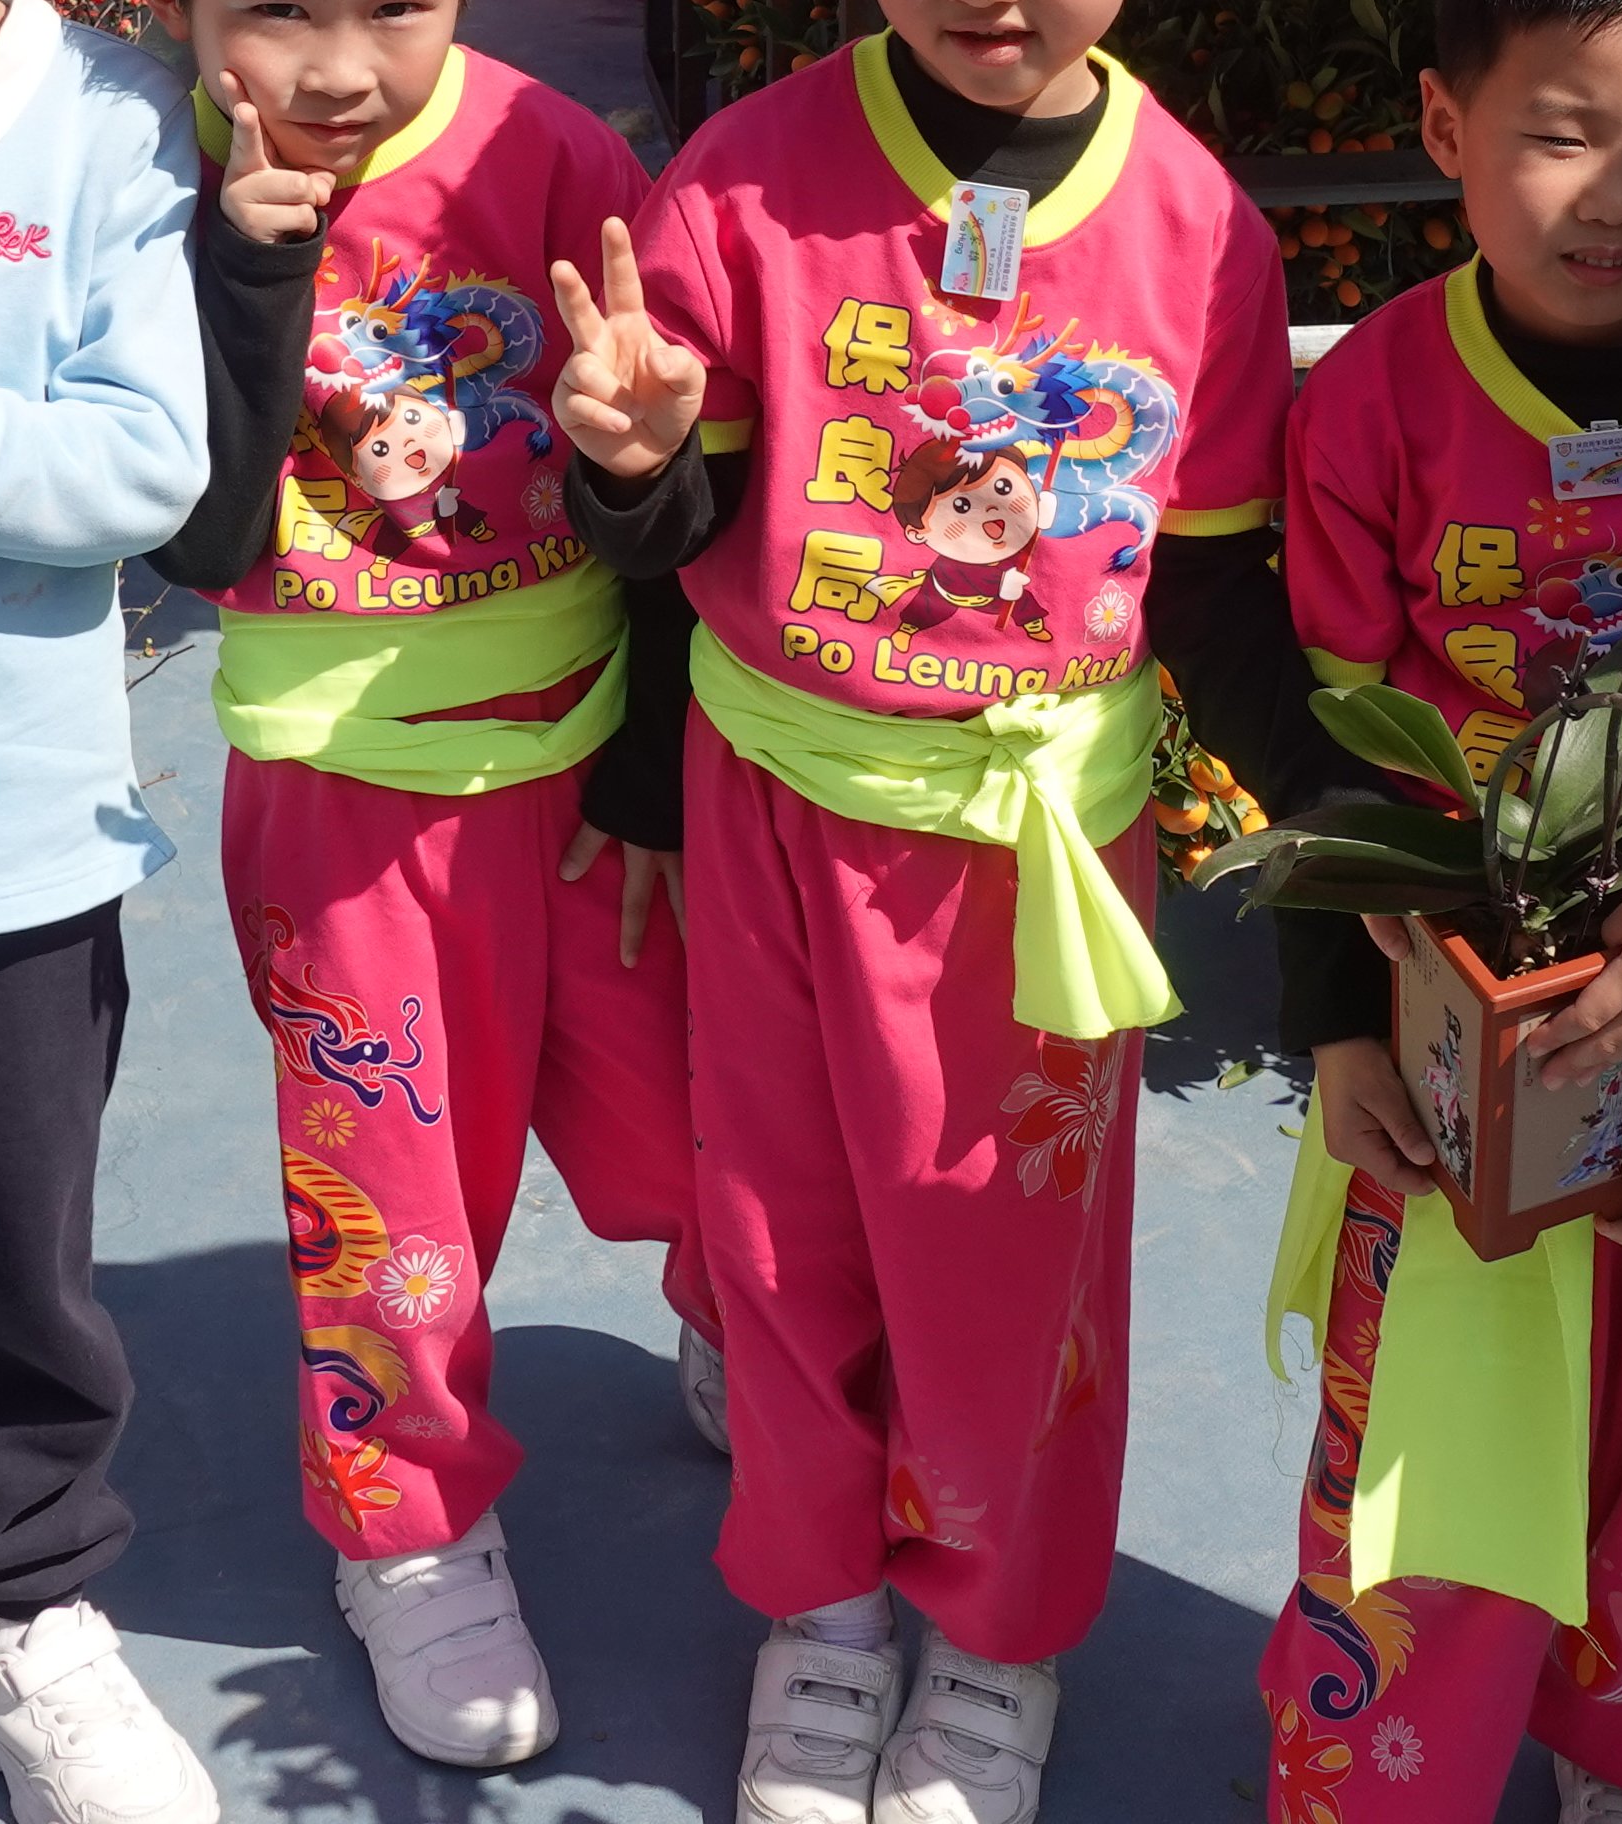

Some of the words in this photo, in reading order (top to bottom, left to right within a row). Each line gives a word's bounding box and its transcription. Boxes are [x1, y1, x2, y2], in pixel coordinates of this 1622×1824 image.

[789, 296, 912, 624] 保良局
[274, 568, 338, 611] Po
[356, 557, 521, 610] Leung
[528, 534, 588, 580] Ku
[1431, 522, 1532, 796] 保良局
[781, 622, 854, 674] Po
[873, 636, 1048, 699] Leung
